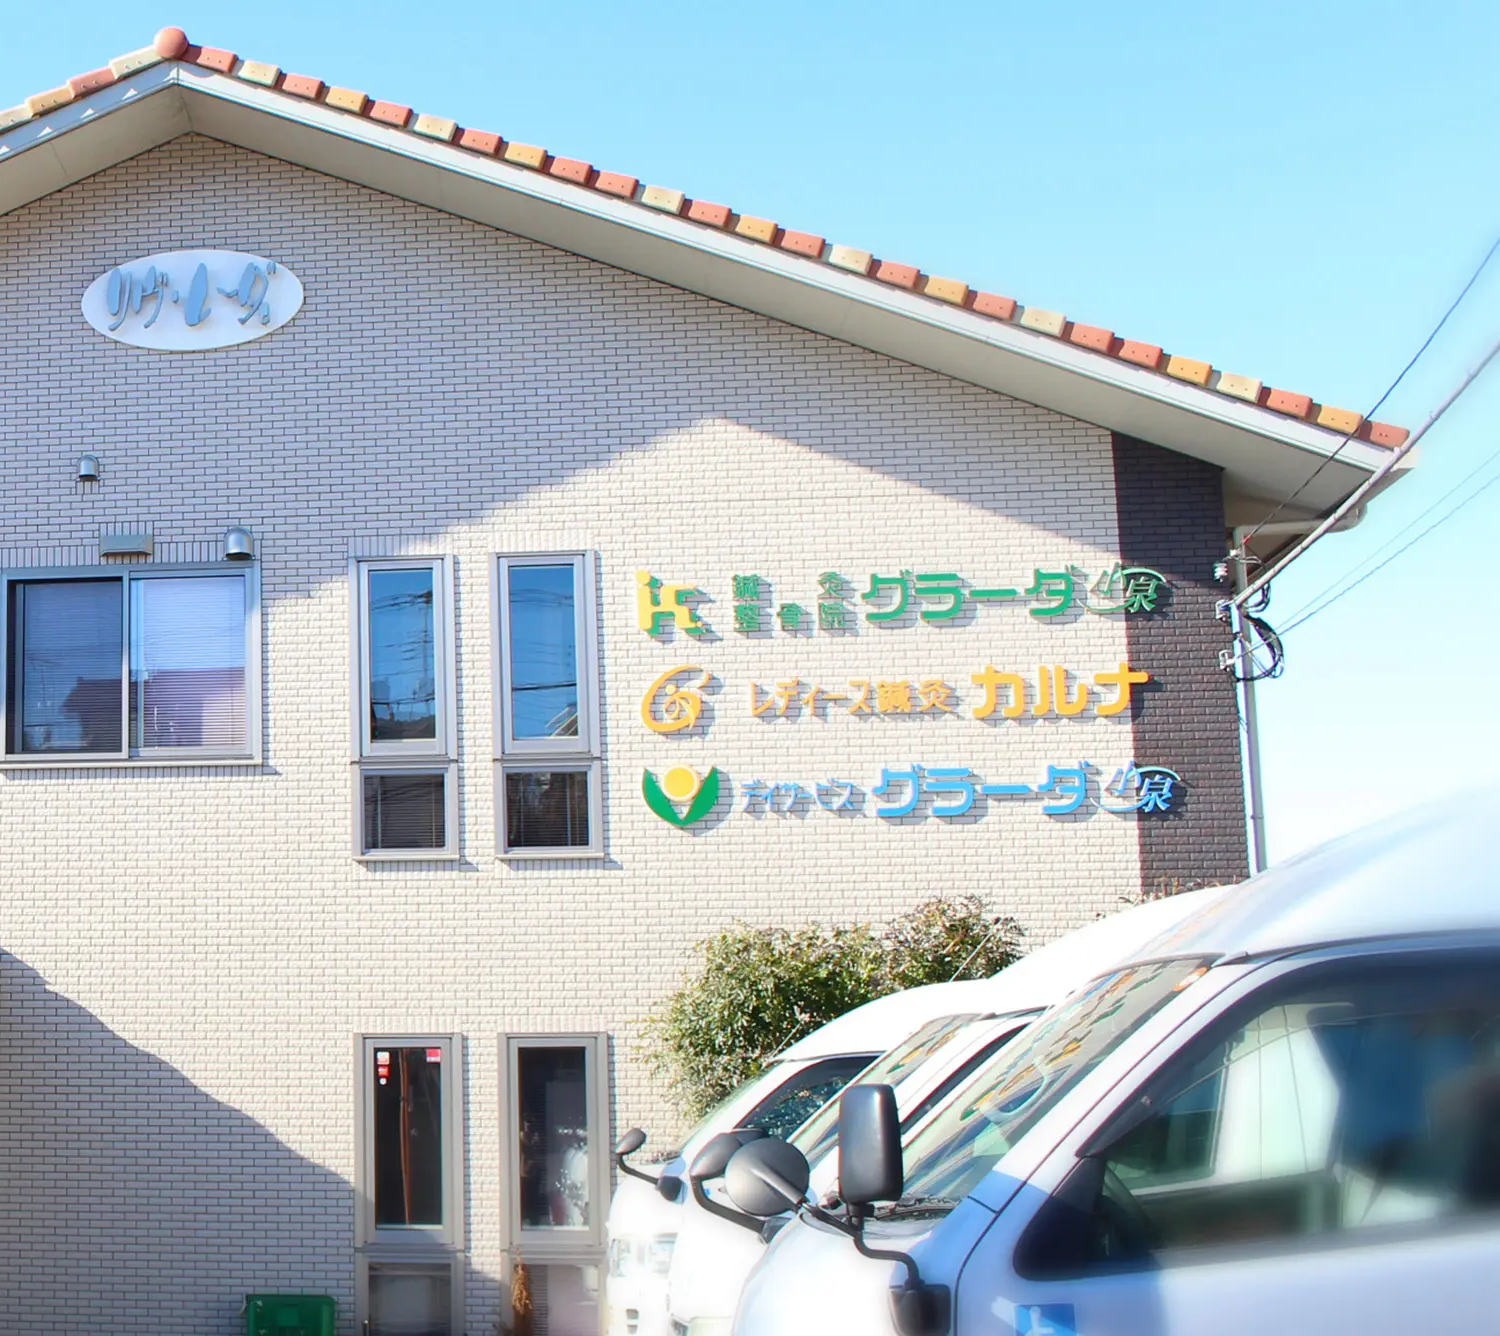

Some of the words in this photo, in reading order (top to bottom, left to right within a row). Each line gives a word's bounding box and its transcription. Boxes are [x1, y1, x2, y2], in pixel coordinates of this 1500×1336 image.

[861, 564, 1078, 623] グラーダ
[970, 662, 1150, 720] カルナ
[872, 759, 1092, 817] グラーダ
